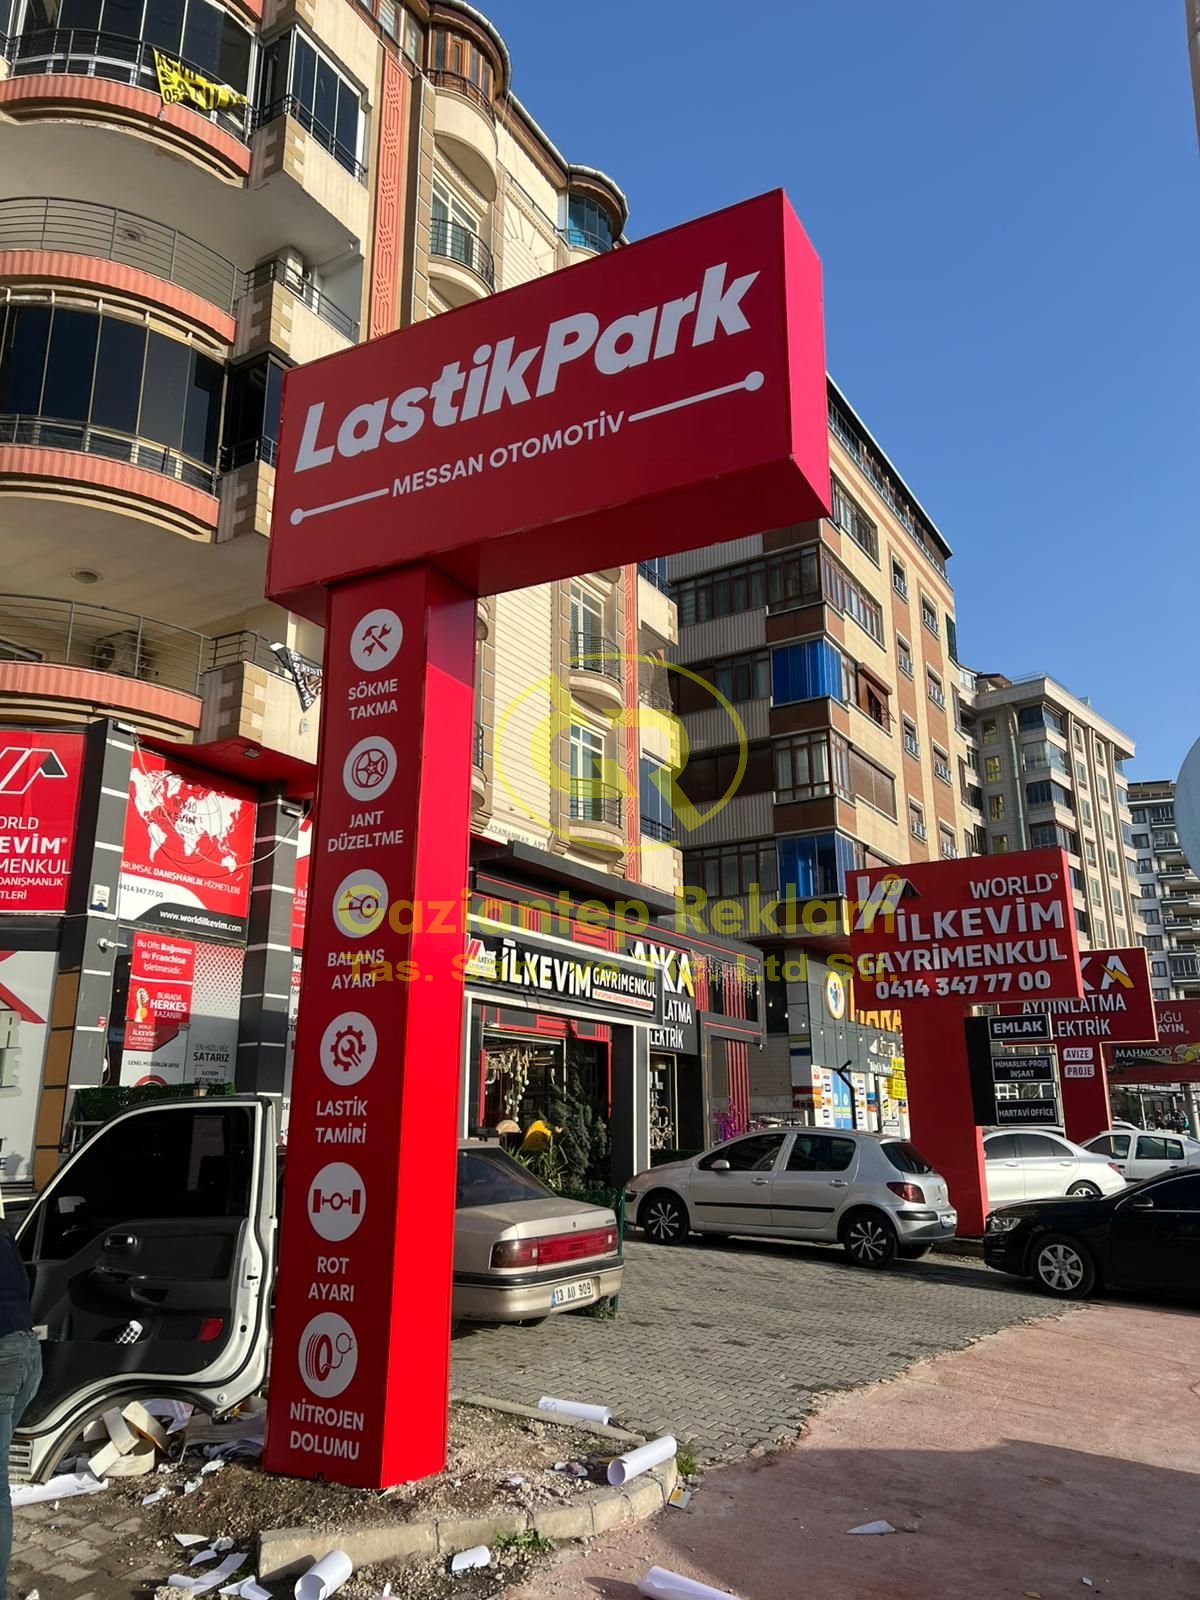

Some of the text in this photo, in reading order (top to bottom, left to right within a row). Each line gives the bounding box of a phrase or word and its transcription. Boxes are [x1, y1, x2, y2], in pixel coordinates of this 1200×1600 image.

[294, 262, 760, 473] LastikPark
[392, 411, 625, 498] MESSAN OTOMOTİV
[348, 678, 398, 700] SÖKME
[349, 699, 398, 720] TAKMA
[349, 810, 384, 829] JANT
[327, 830, 404, 852] DÜZELTME
[153, 867, 205, 886] DANIŞMANLIK
[969, 873, 1052, 899] WORLD
[897, 898, 1064, 942] İLKEVİM
[151, 953, 186, 965] Franchise
[327, 949, 385, 967] BALANS
[857, 938, 1067, 975] GAYRİMENKUL
[501, 938, 591, 998] İLKEVİM
[592, 967, 657, 999] GAYRİMENKUL
[331, 973, 377, 989] AYARI
[875, 969, 1051, 1000] 0414 347 77 00
[150, 1000, 188, 1012] HERKES
[993, 1020, 1042, 1034] EMLAK
[193, 1052, 230, 1063] SATARIZ
[1067, 1066, 1092, 1076] PROJE
[315, 1096, 368, 1116] LASTİK
[315, 1122, 367, 1144] TAMİRİ
[317, 1256, 349, 1275] ROT
[308, 1282, 355, 1302] AYARI
[555, 1289, 564, 1303] 13
[578, 1282, 592, 1296] 909
[289, 1397, 364, 1431] NİTROJEN
[289, 1430, 360, 1461] DOLUMU
